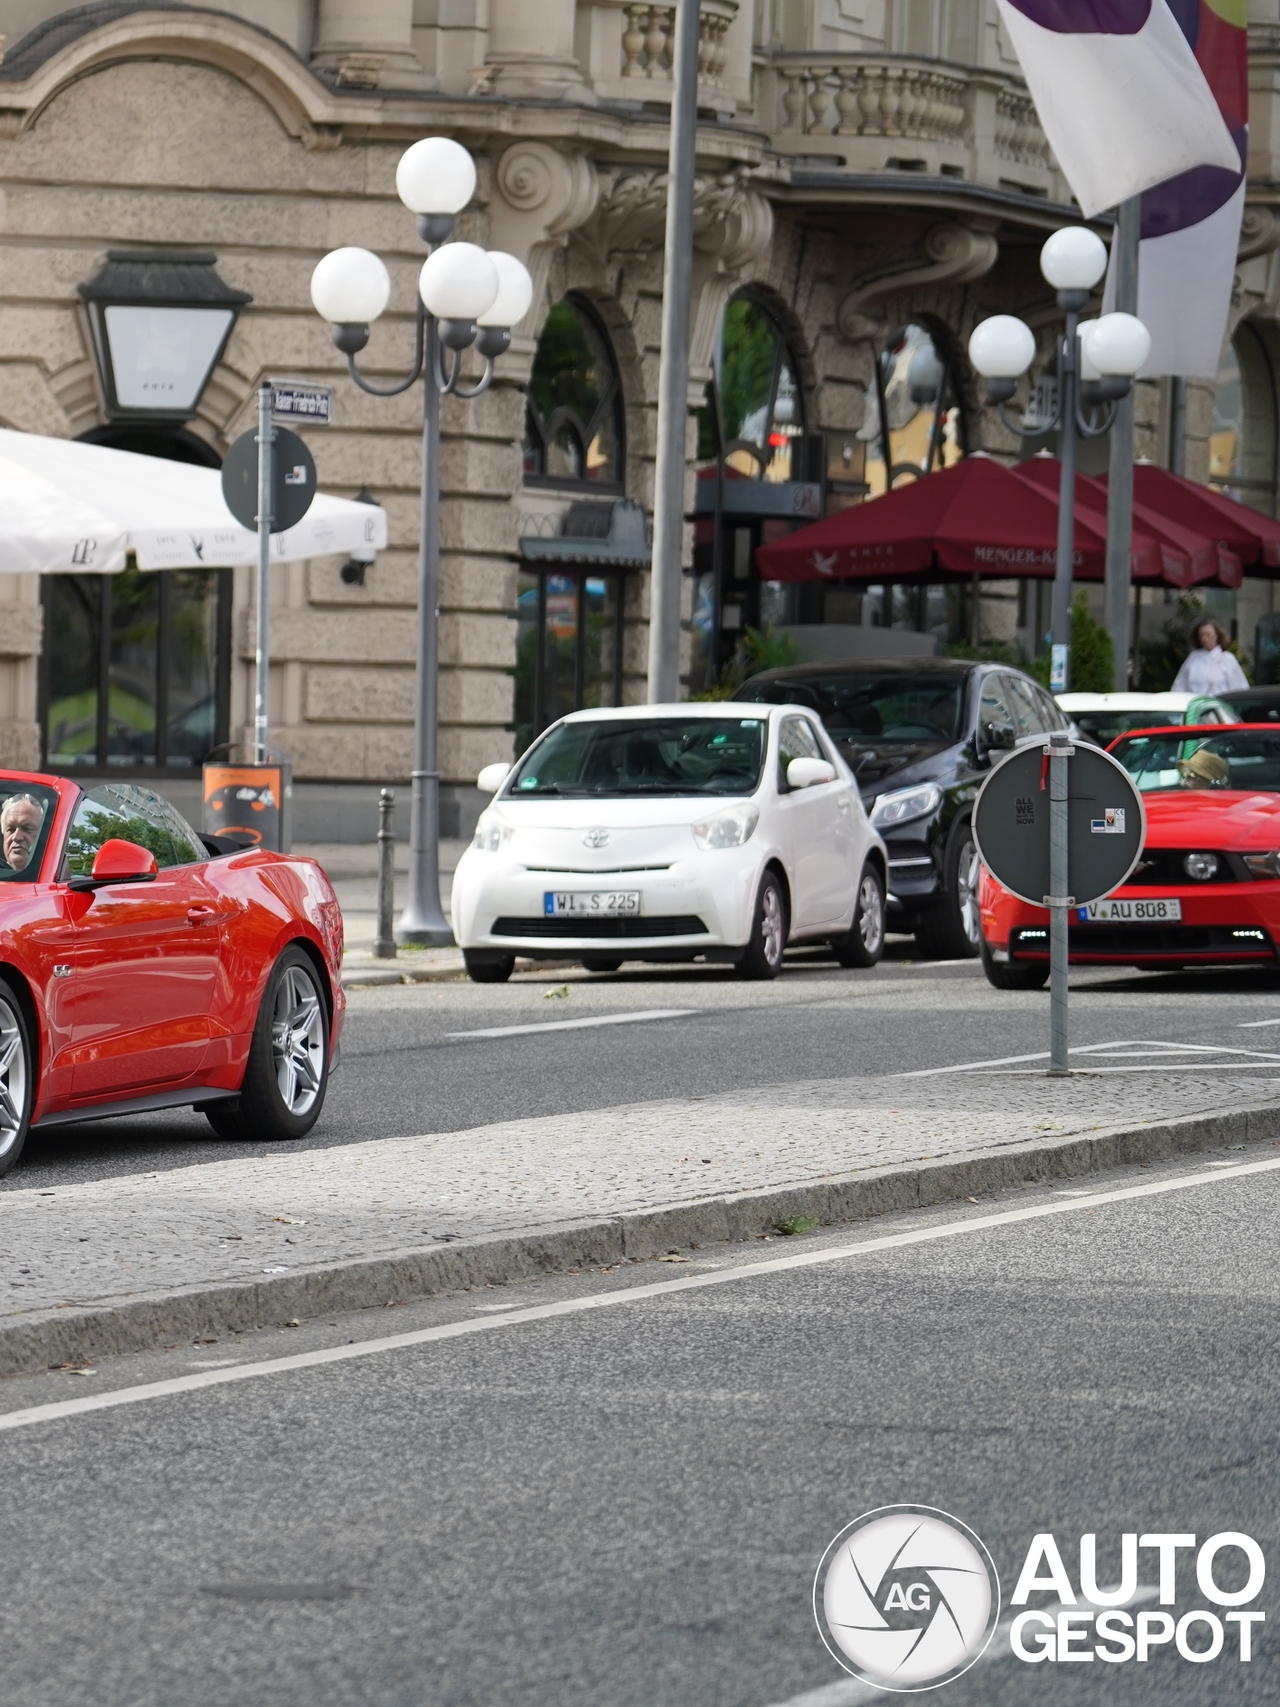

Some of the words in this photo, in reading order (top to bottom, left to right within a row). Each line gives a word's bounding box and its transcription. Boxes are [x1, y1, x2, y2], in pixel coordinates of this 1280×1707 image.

[974, 546, 1083, 566] MENGER-KG
[1016, 805, 1034, 814] WE
[557, 894, 576, 910] WI
[591, 894, 600, 910] S
[608, 894, 637, 910] 225
[1110, 903, 1132, 918] AU
[1135, 902, 1167, 918] 808
